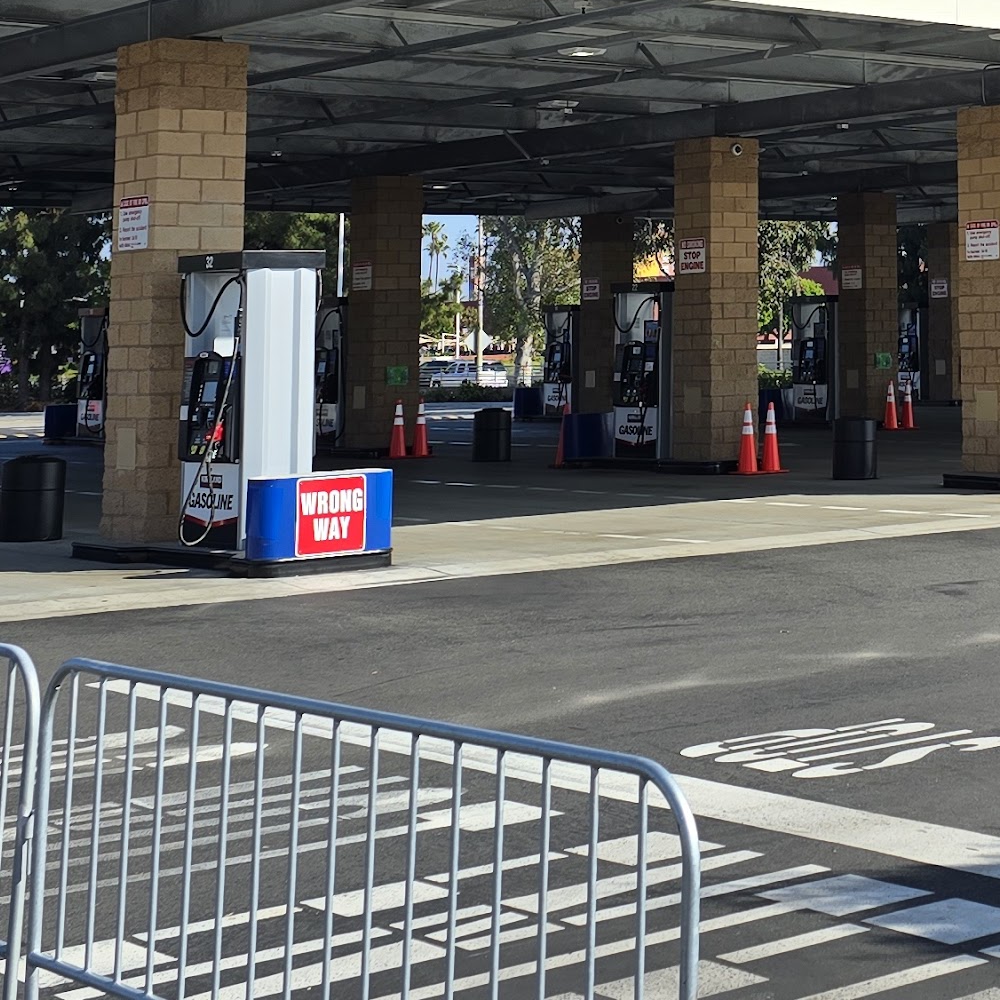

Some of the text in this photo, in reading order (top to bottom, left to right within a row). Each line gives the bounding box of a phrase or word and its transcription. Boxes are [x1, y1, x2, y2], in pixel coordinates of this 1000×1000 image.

[684, 251, 701, 260] STOP
[205, 256, 214, 269] 32
[681, 261, 704, 270] ENGINE
[619, 425, 653, 436] GASONE
[300, 488, 364, 516] WRONG
[313, 516, 351, 542] WAY
